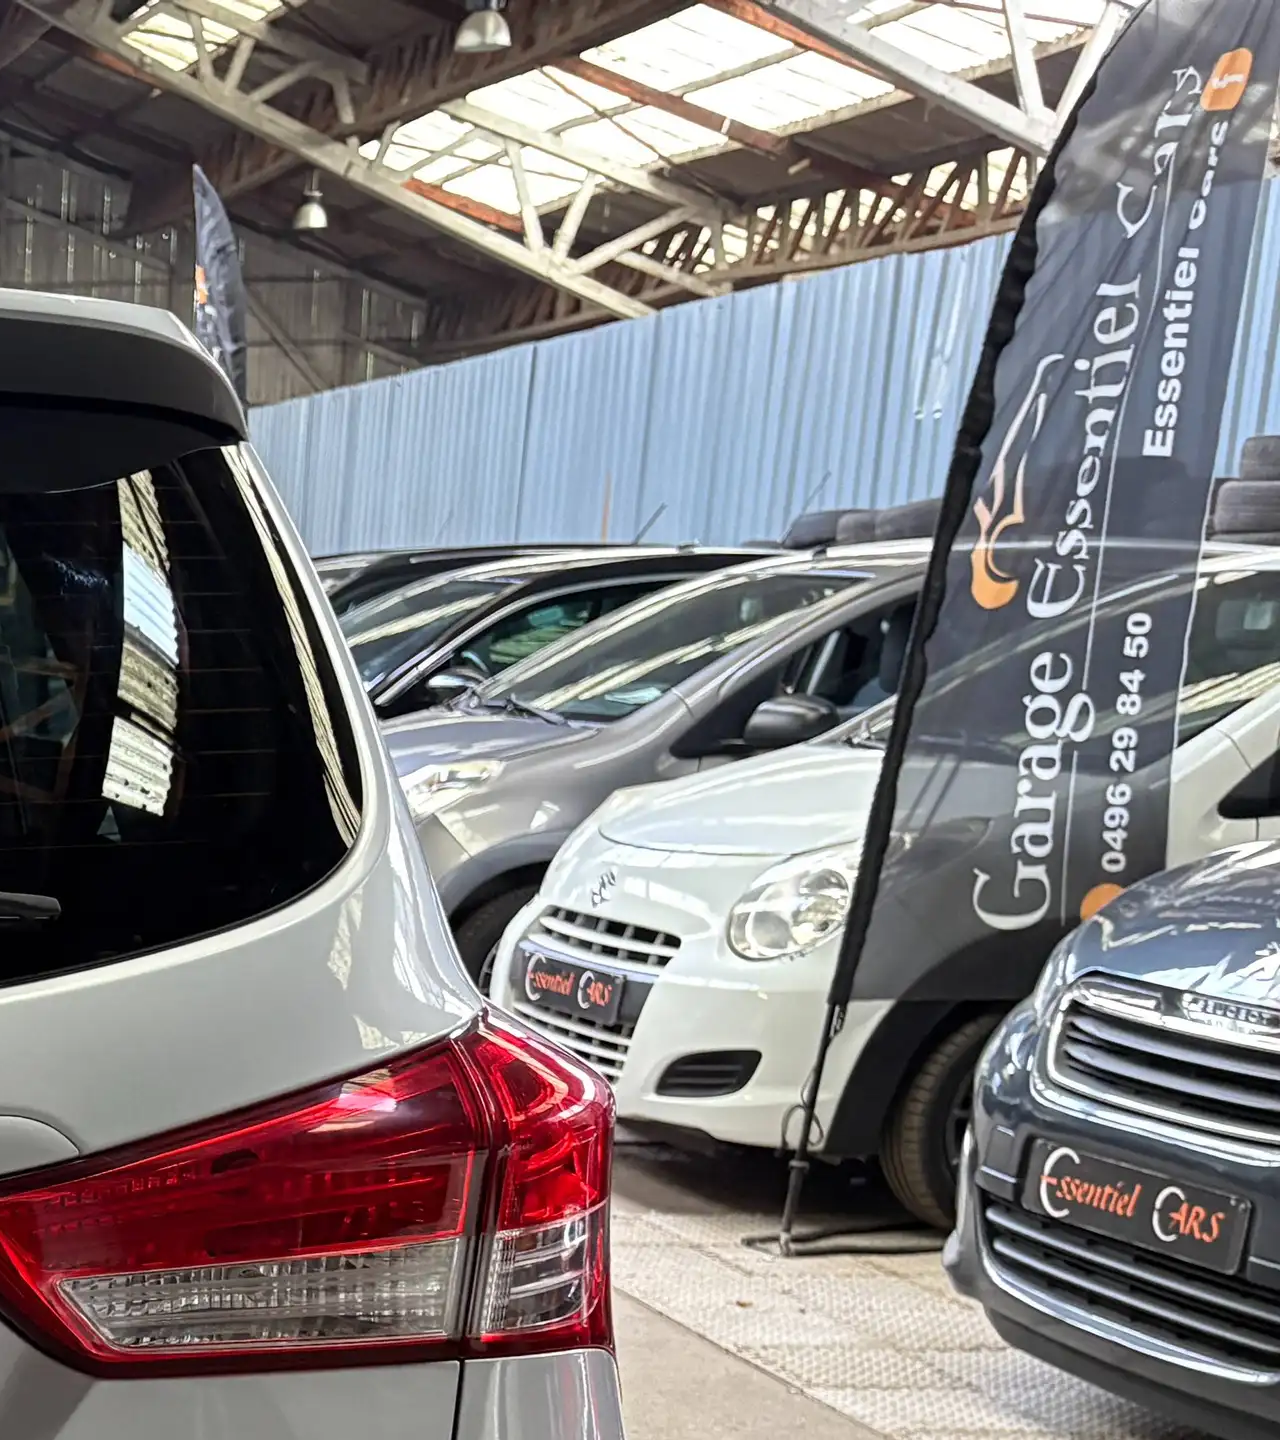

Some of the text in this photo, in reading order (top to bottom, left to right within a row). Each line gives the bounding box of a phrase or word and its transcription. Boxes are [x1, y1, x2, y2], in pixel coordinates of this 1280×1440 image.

[1026, 273, 1141, 619] Essentiel
[1142, 247, 1200, 457] Essentiel
[972, 651, 1095, 931] Garage
[1101, 612, 1152, 873] 0496 29 84 50
[1040, 1147, 1142, 1218] Essentiel
